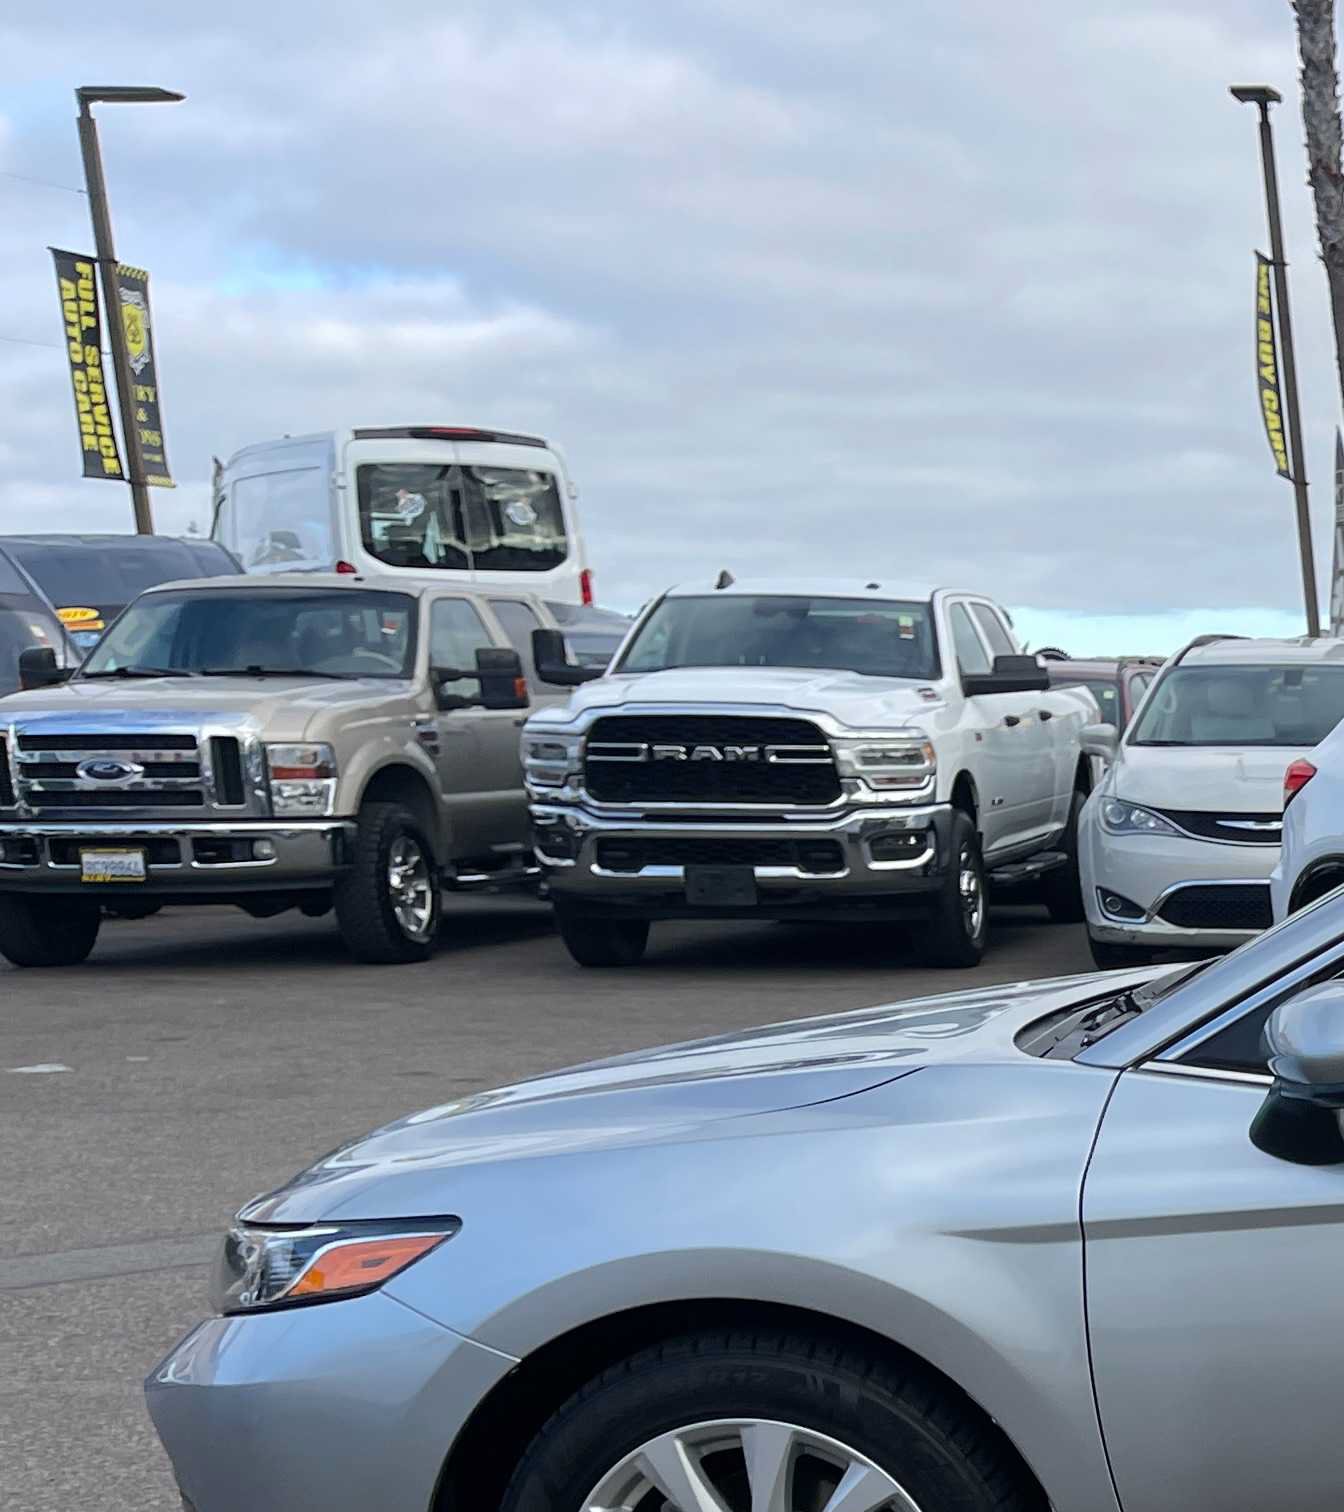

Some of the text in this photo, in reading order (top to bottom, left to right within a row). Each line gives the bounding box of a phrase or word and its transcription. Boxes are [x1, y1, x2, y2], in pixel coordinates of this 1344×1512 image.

[60, 278, 98, 451] AUTO CARE
[75, 261, 121, 475] FULL SERVICE
[1258, 319, 1276, 385] BUY
[653, 744, 759, 761] RAM
